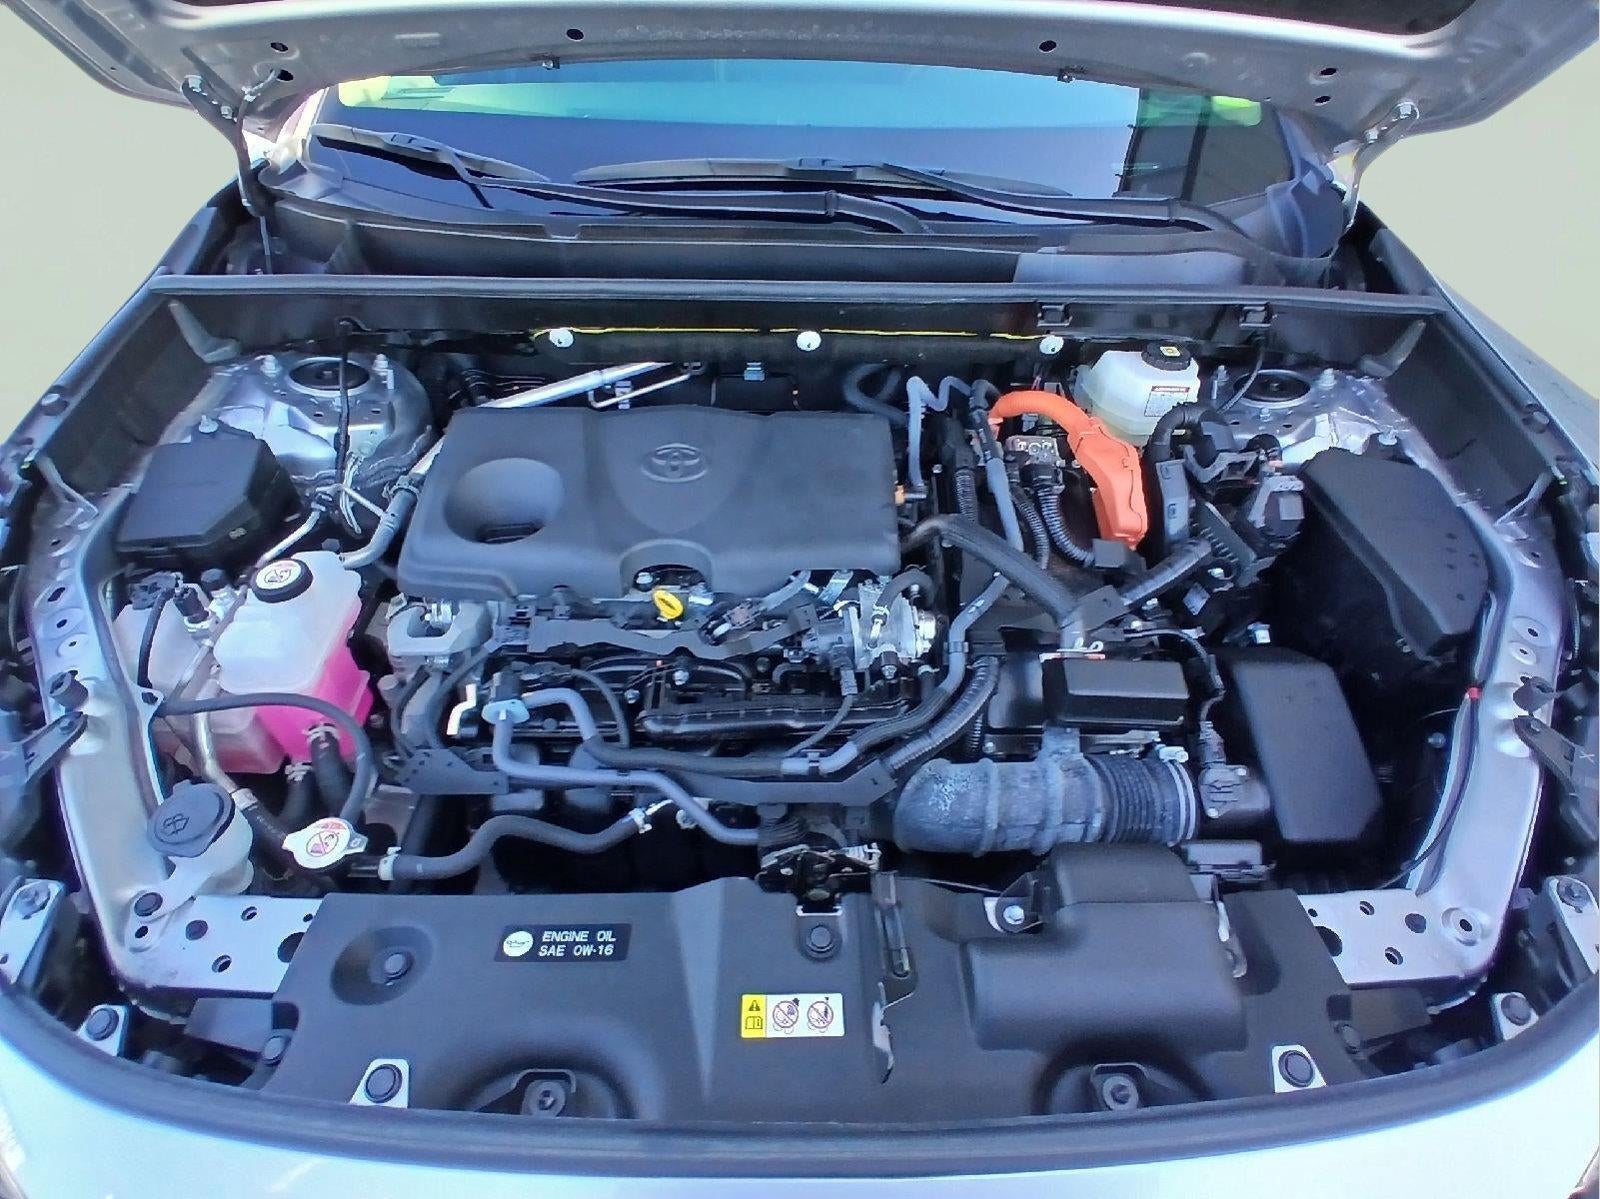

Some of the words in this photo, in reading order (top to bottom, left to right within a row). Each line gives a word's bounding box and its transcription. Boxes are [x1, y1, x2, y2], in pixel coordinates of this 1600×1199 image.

[542, 930, 589, 942] ENGINE
[597, 930, 617, 942] OIL
[538, 944, 566, 957] SAE
